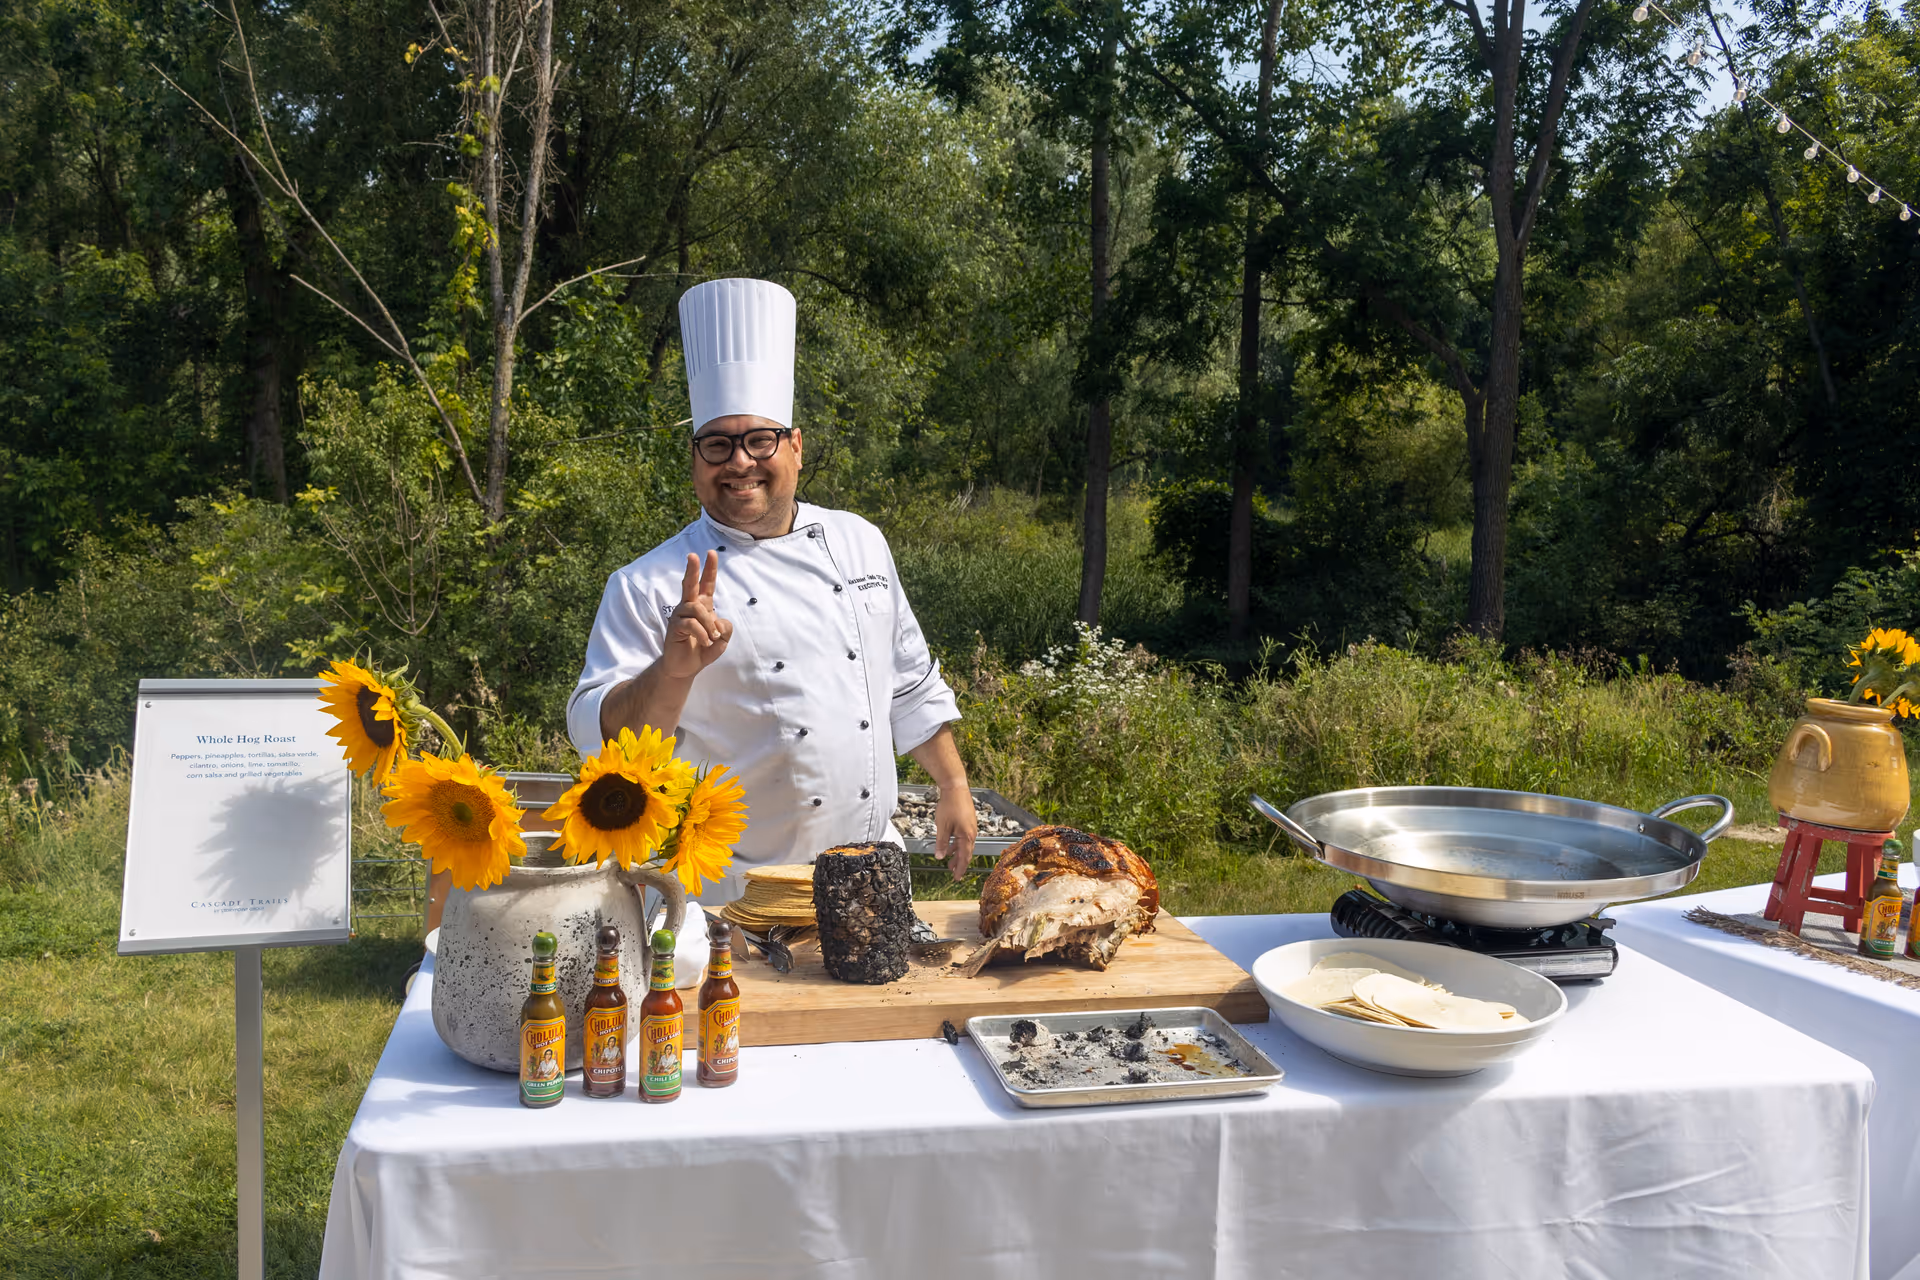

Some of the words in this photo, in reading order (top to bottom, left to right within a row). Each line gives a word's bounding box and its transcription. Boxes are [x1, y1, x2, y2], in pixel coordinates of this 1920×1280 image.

[196, 735, 233, 744] Whole
[237, 734, 260, 745] Hog
[264, 734, 296, 743] Roast
[171, 753, 203, 761] Peppers,
[205, 752, 246, 760] pineapples,
[239, 771, 262, 779] grilled
[263, 770, 303, 778] vegetables
[525, 1025, 564, 1048] CHOLULA
[536, 1041, 548, 1049] HOT
[717, 1056, 737, 1065] CHIPO
